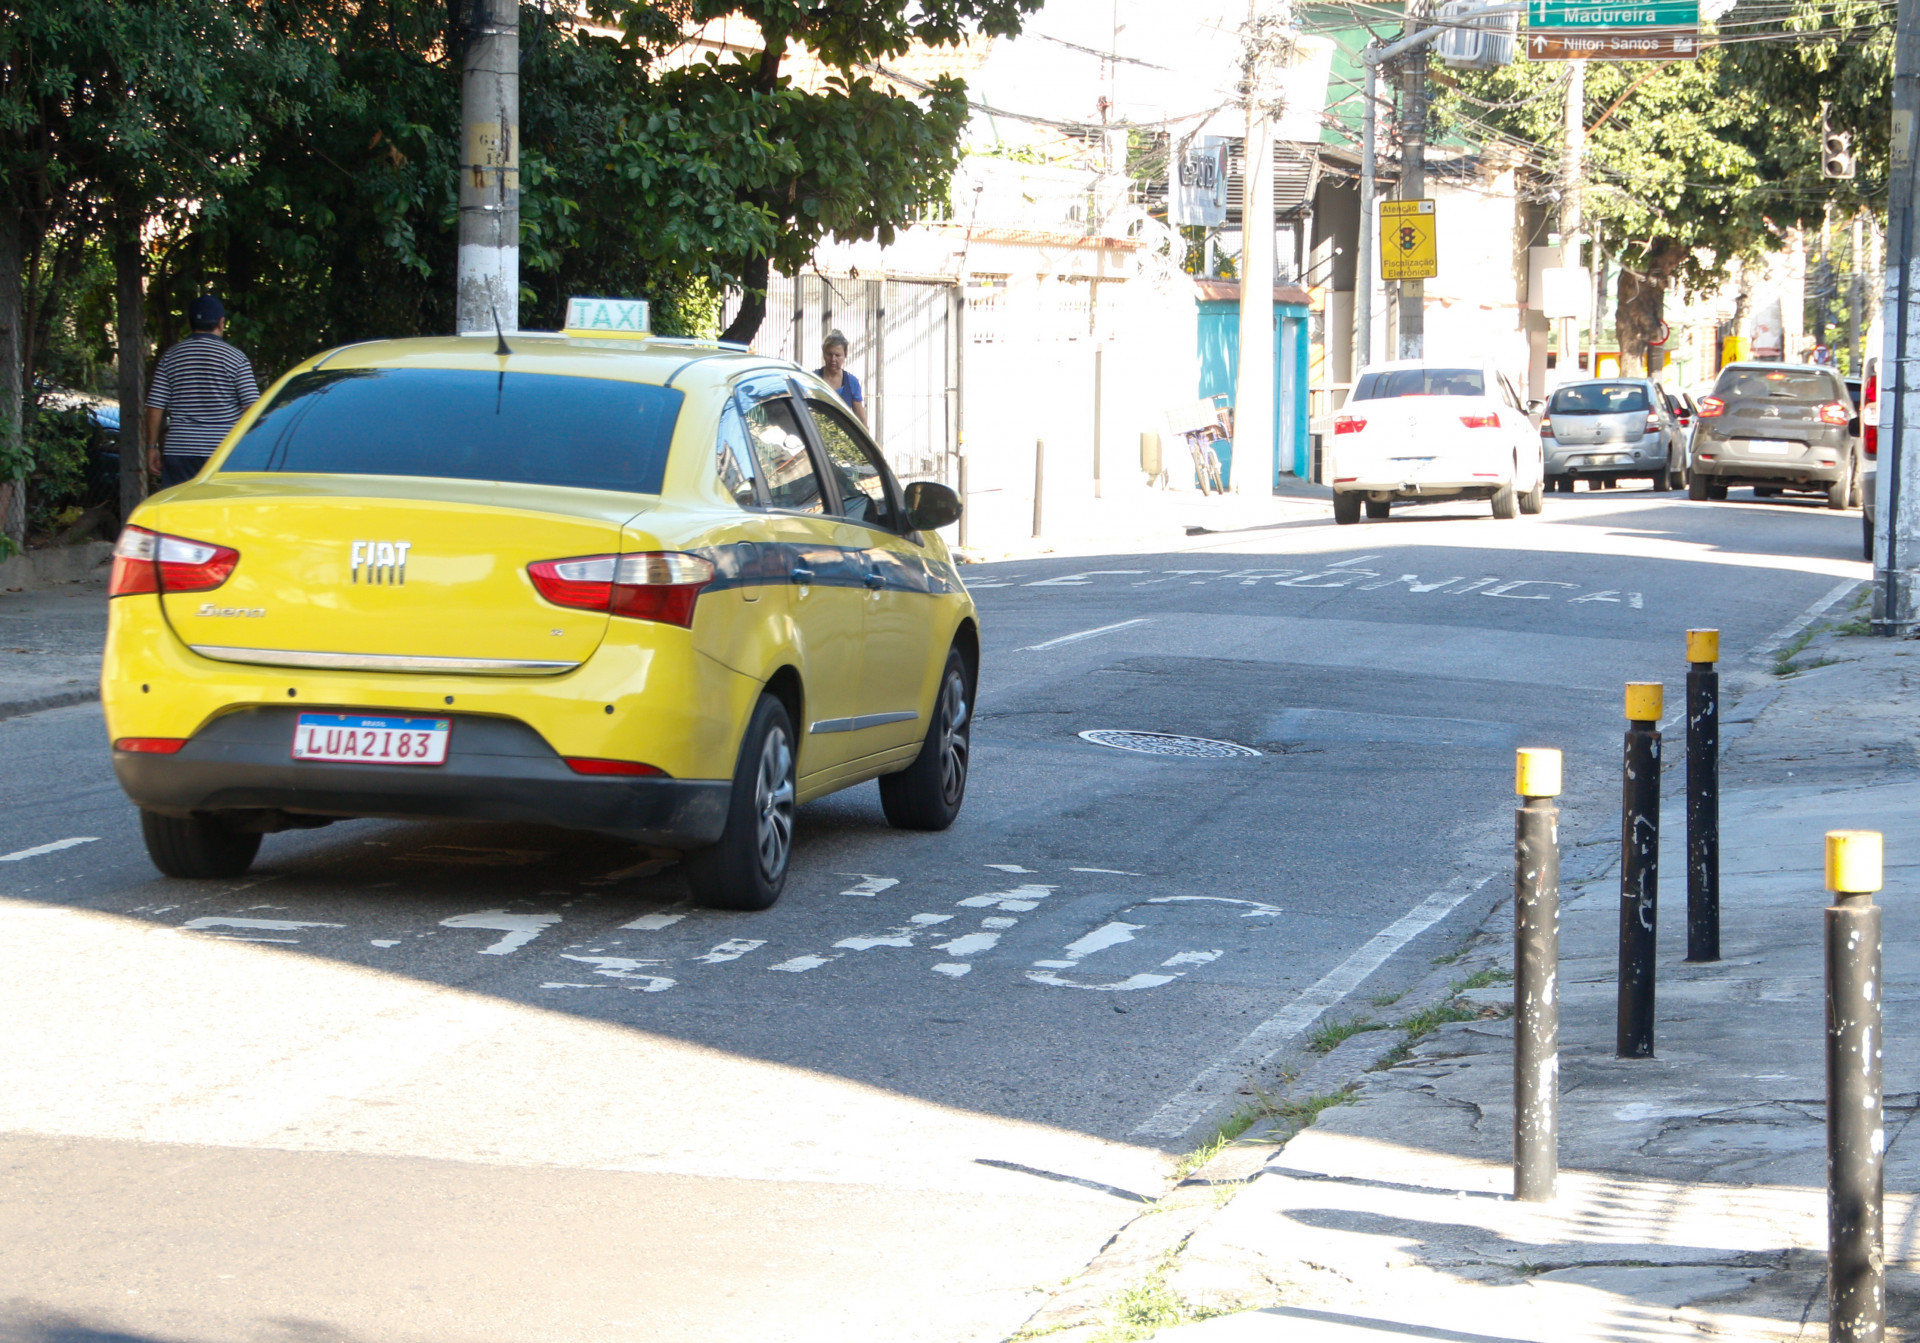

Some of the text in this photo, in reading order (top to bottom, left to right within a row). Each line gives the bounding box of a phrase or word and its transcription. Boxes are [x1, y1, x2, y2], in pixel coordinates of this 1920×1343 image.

[1564, 8, 1656, 22] Madureira
[1564, 37, 1659, 50] Nilton Santos
[1382, 205, 1417, 213] Atenção
[1383, 258, 1434, 268] Fiscalização
[1388, 267, 1430, 277] Eletrônica
[573, 302, 644, 329] TAXI
[352, 541, 411, 585] FIAT
[195, 602, 266, 618] Siena
